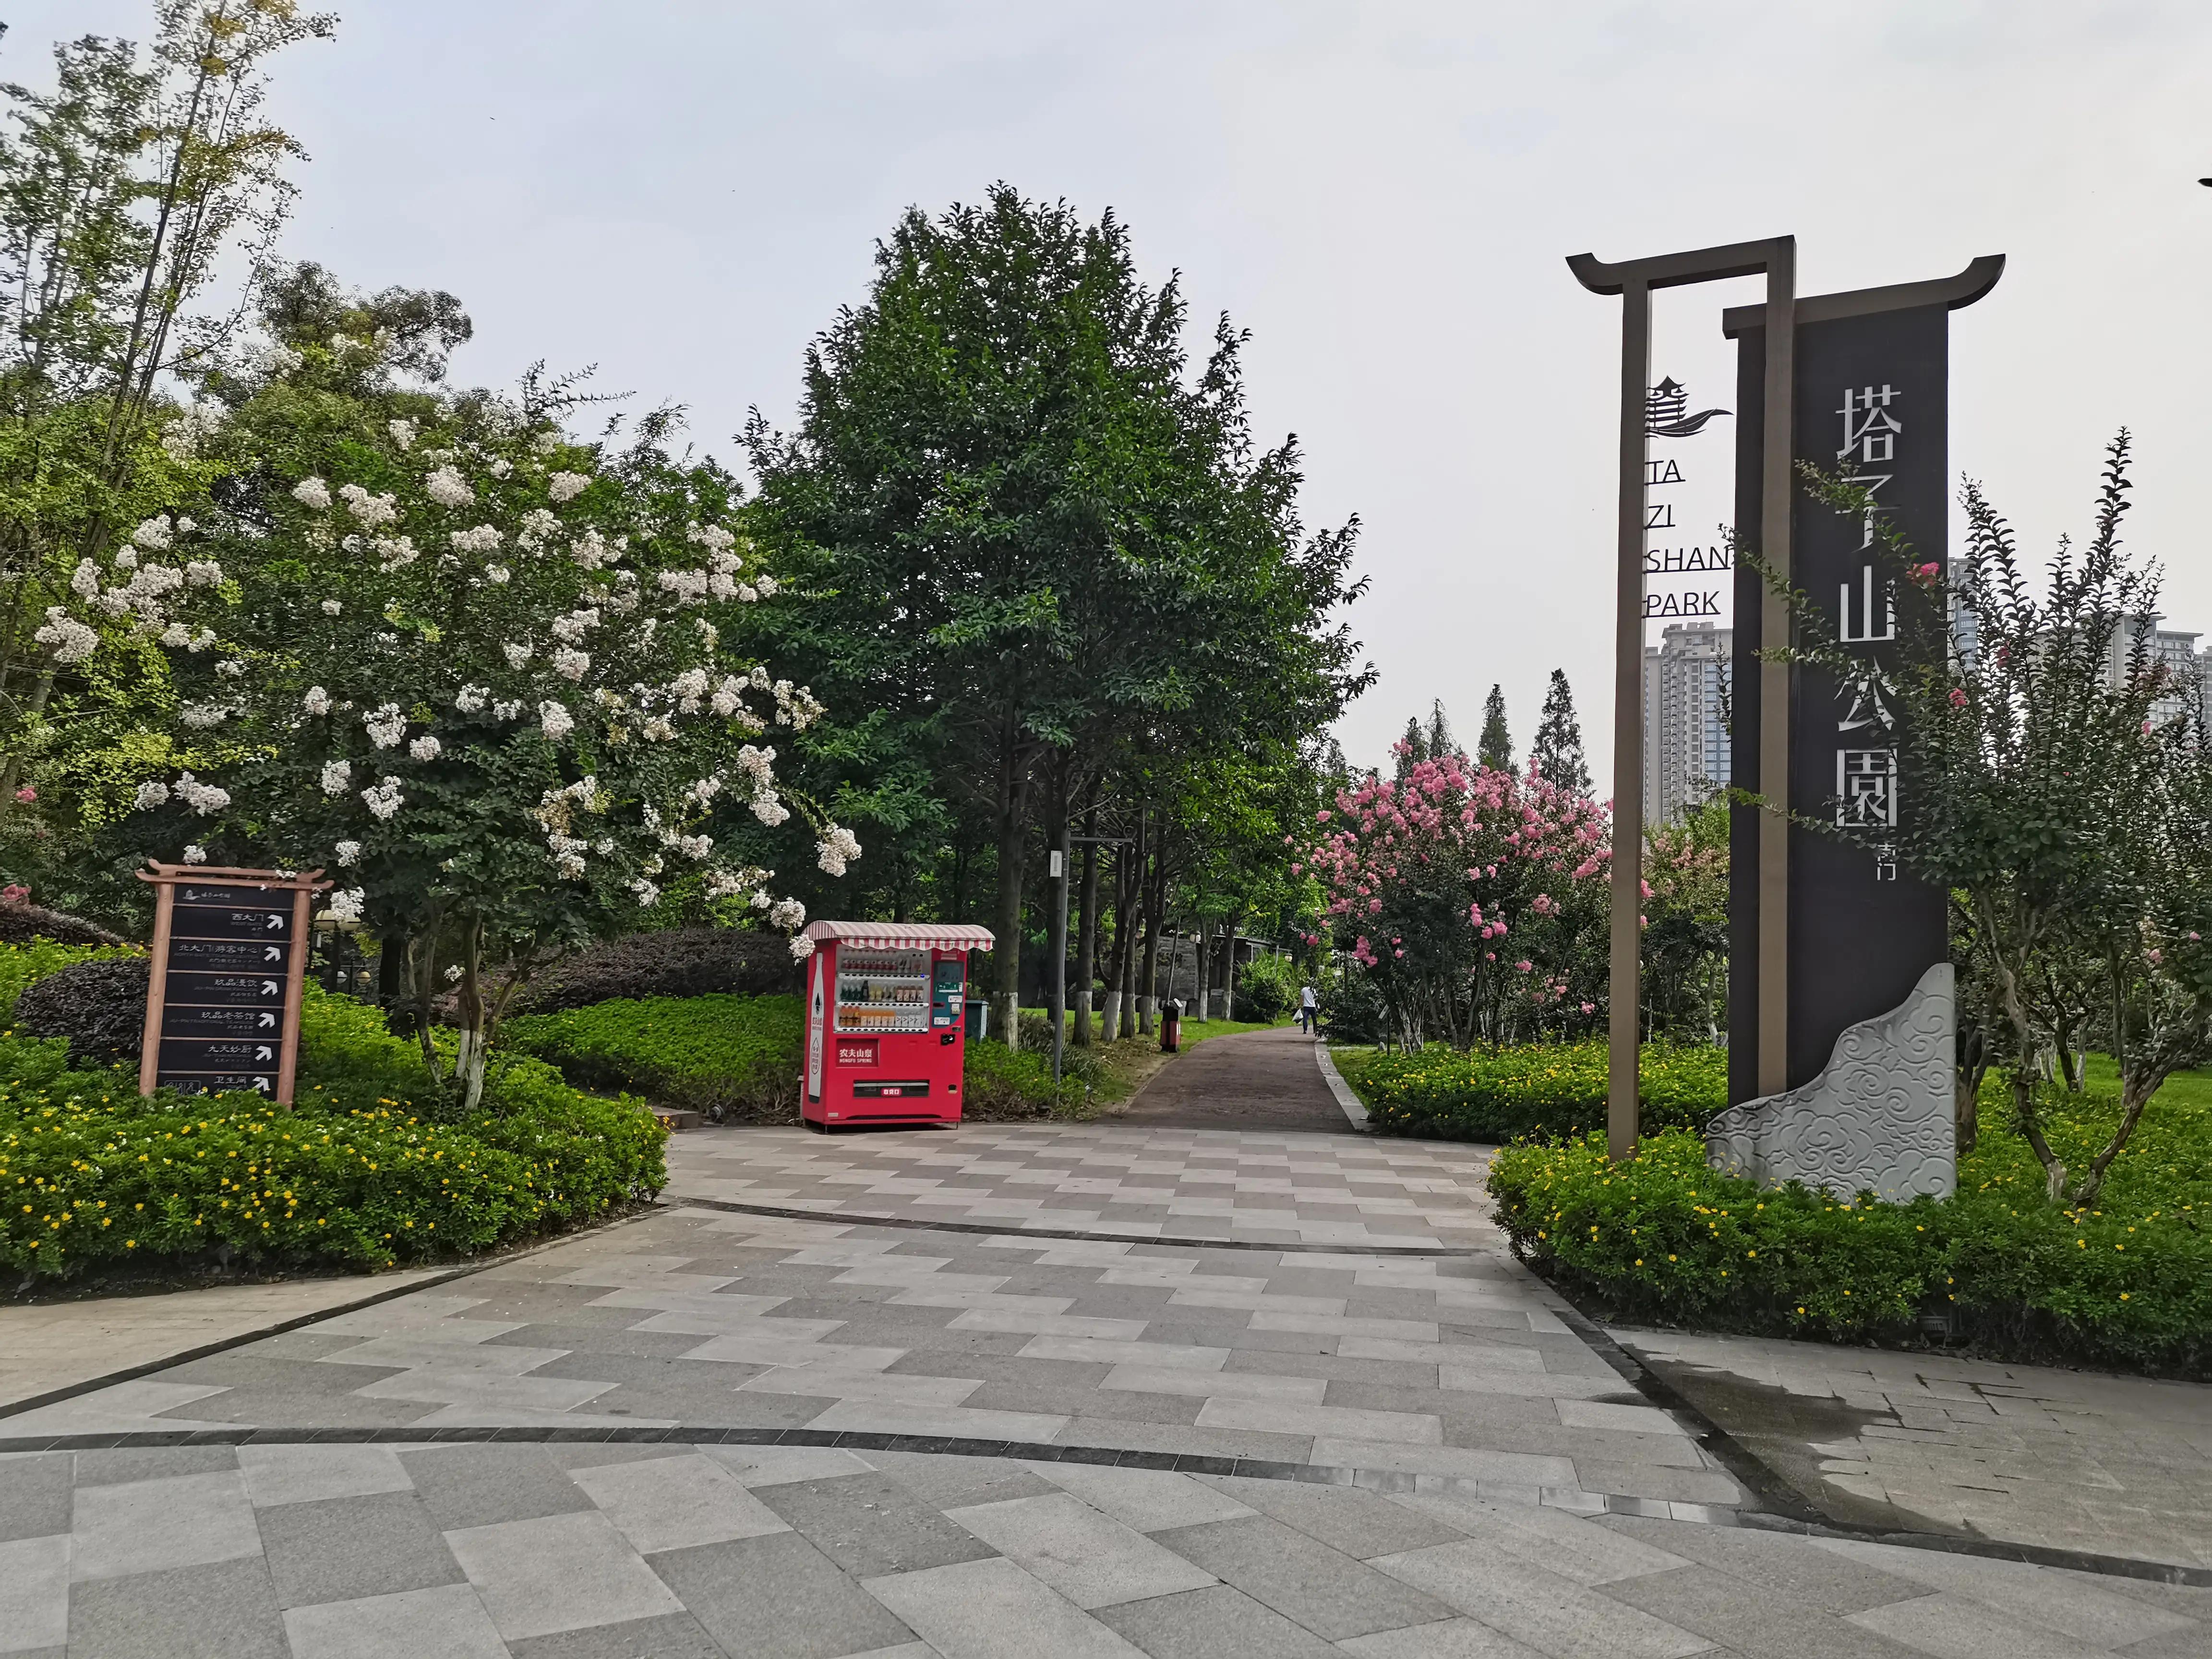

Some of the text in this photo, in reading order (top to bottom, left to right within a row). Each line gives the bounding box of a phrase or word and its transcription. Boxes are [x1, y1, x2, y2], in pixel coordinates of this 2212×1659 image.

[1645, 459, 1685, 484] TA
[1646, 504, 1675, 529] ZI
[1646, 546, 1731, 573] SHAN
[1645, 590, 1721, 617] PARK
[231, 913, 264, 922] 西大门
[839, 1048, 872, 1058] 农夫山泉
[214, 1076, 247, 1084] 卫生间
